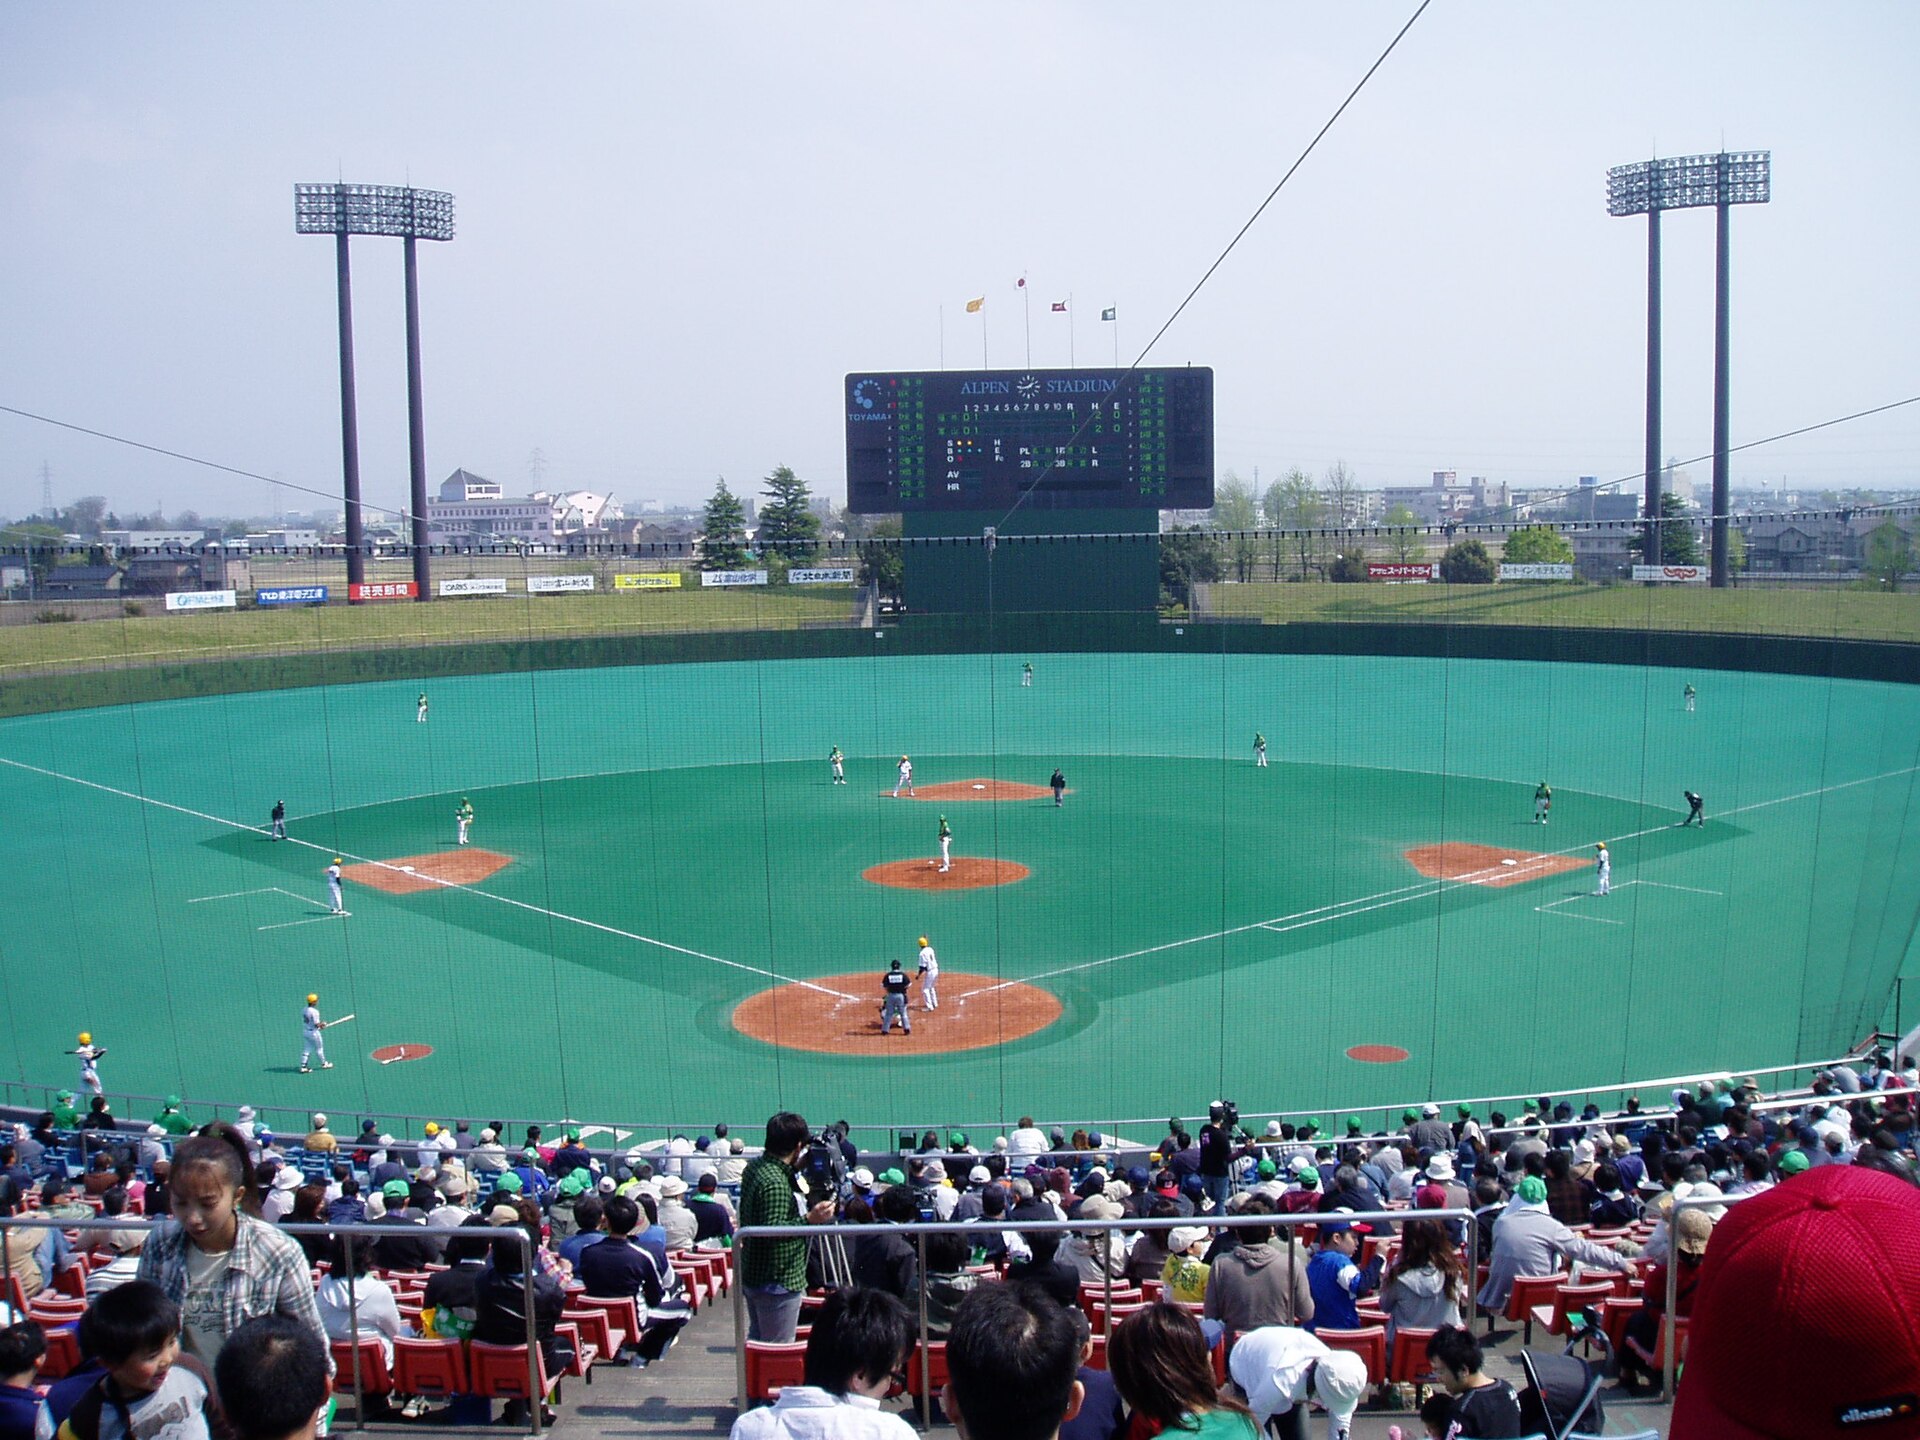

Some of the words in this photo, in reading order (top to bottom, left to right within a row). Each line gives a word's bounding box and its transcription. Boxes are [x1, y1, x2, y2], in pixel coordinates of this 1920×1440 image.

[961, 381, 1009, 394] ALPEN
[1047, 380, 1117, 392] STADIUM
[963, 413, 969, 421] 0
[1095, 411, 1102, 419] 2
[1114, 411, 1120, 419] 0
[1370, 566, 1431, 575] アサヒスーパードライ
[802, 571, 850, 580] 北日本新聞
